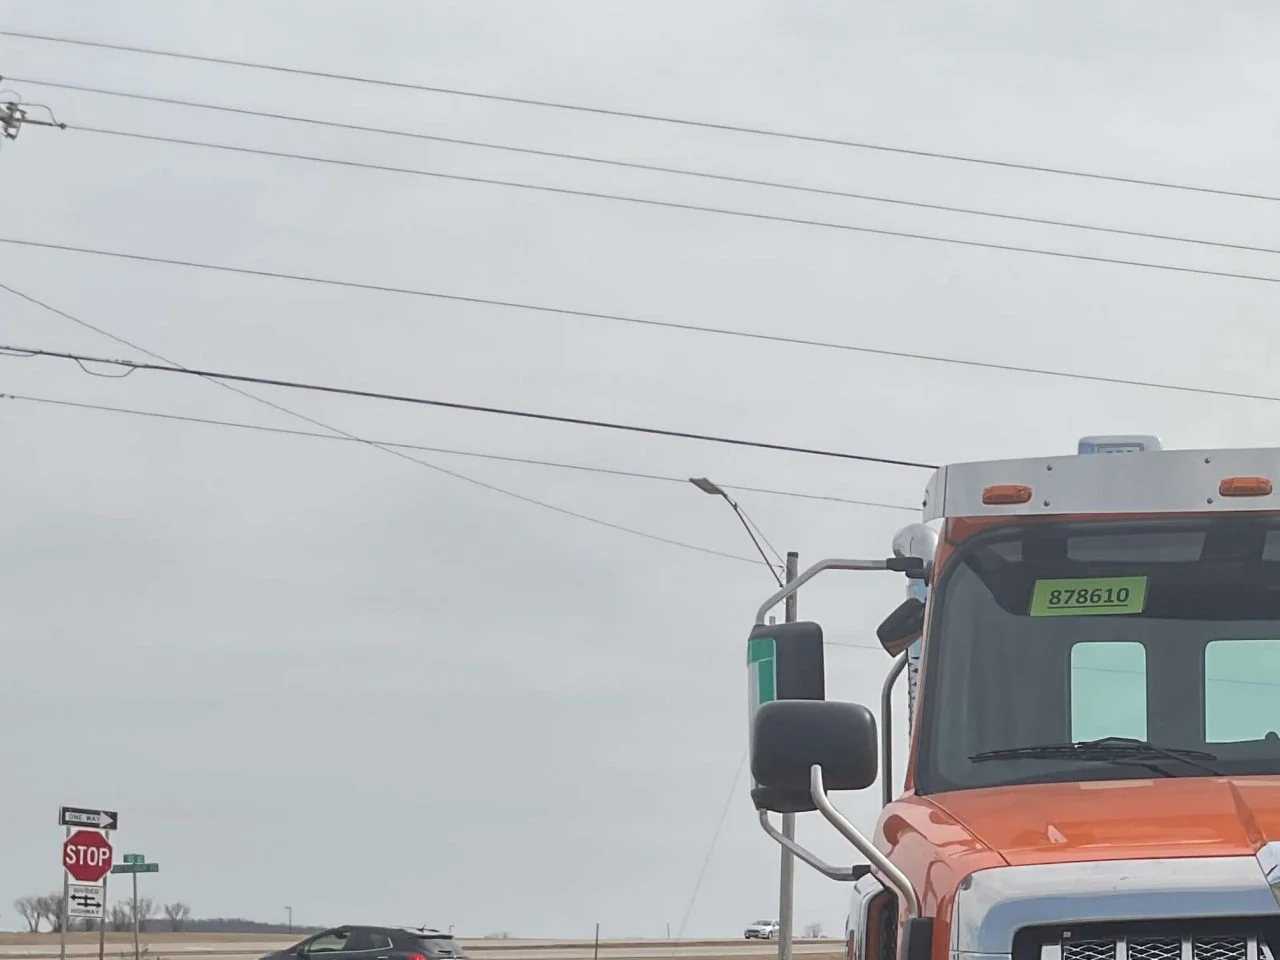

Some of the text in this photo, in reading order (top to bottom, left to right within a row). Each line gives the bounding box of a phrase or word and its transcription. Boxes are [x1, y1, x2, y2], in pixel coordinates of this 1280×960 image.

[1047, 587, 1130, 606] 878610
[68, 813, 84, 821] ONE
[65, 844, 110, 867] STOP
